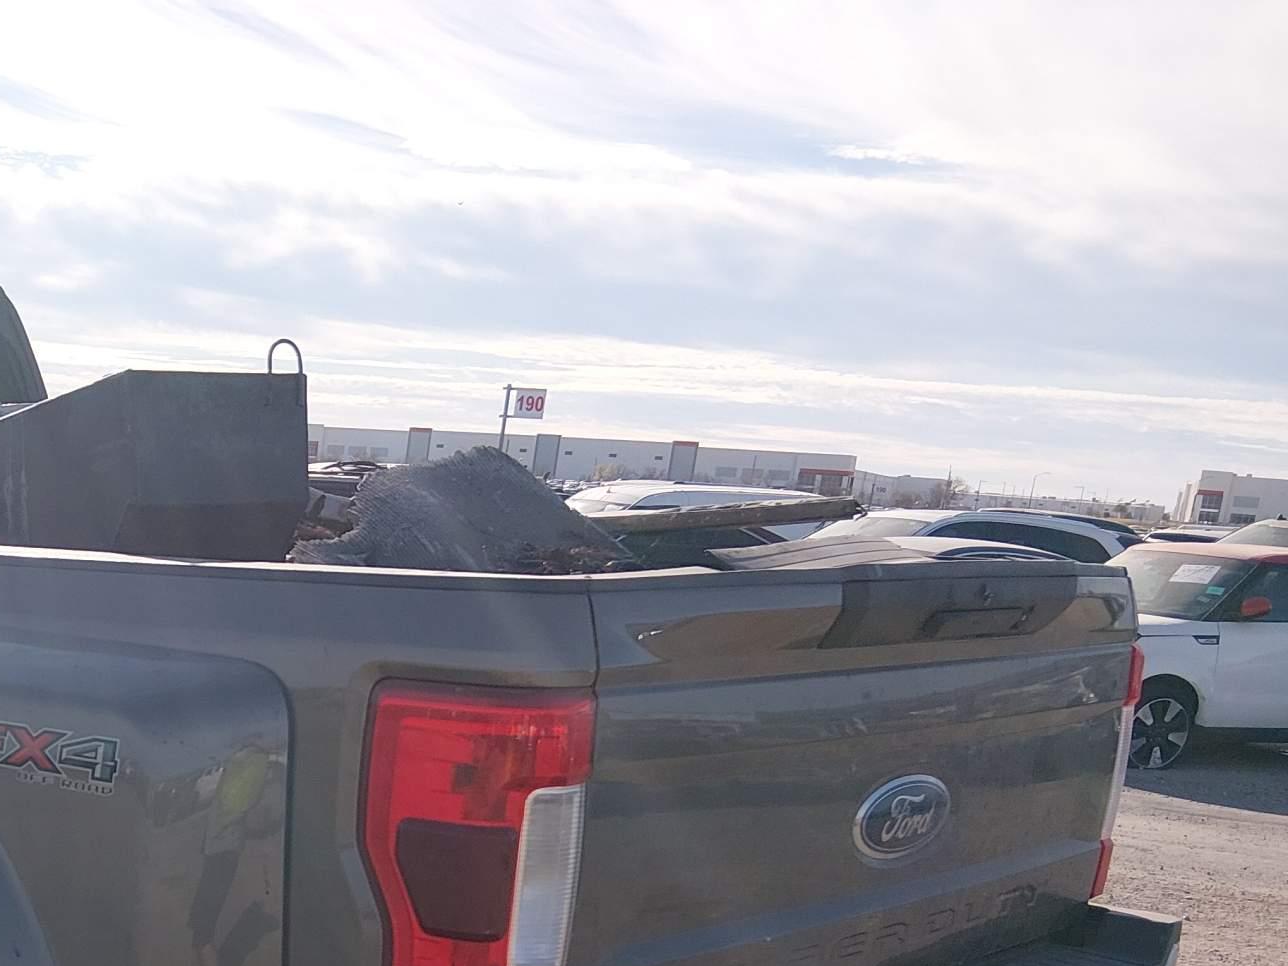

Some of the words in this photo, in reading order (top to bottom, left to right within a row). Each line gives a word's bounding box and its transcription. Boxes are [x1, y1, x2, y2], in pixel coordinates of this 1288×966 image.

[516, 394, 545, 413] 190
[60, 777, 114, 796] ROAD
[881, 794, 937, 842] Ford
